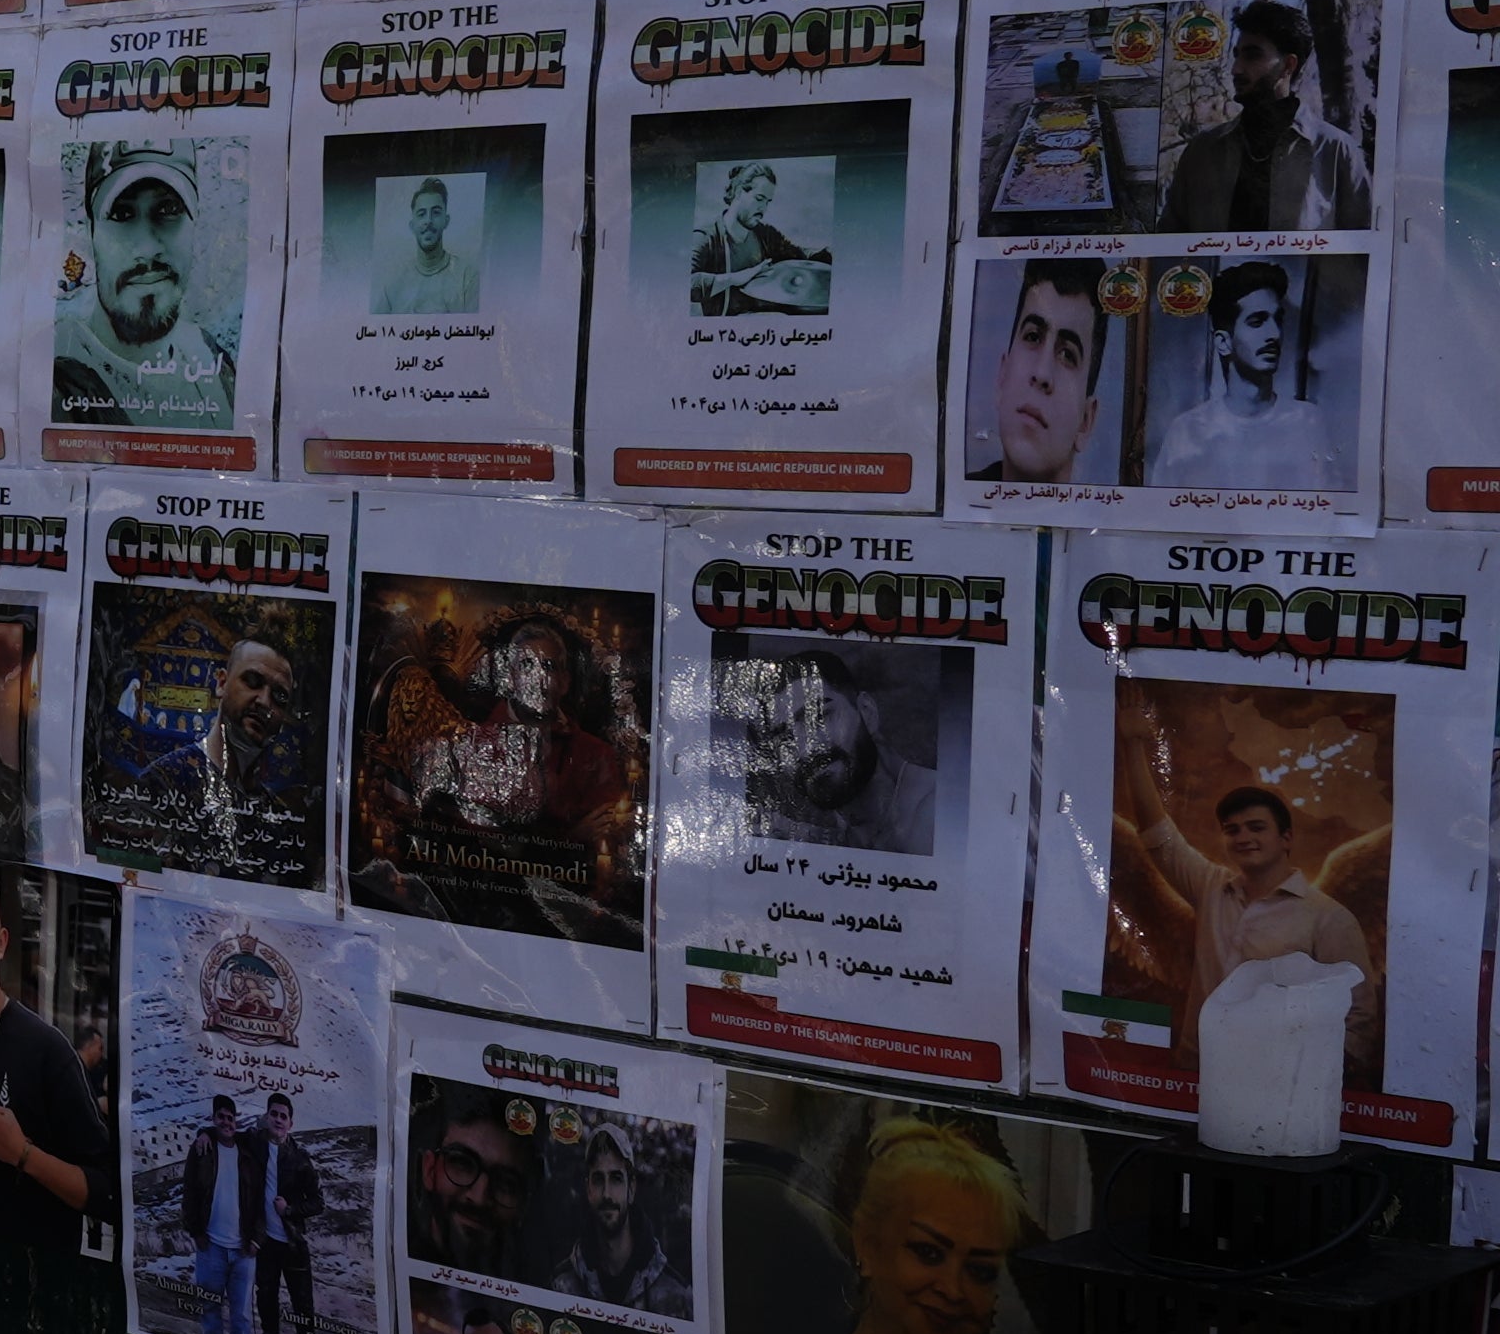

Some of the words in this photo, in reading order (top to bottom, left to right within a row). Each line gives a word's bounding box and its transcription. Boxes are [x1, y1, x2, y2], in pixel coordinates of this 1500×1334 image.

[631, 1, 925, 85] GENOCIDE
[1002, 239, 1039, 255] قاسمی
[1041, 238, 1072, 253] فرزام
[1074, 238, 1092, 251] نام
[1095, 239, 1125, 252] جاوید
[1187, 237, 1232, 253] رستمی
[1237, 235, 1261, 251] رضا
[1265, 234, 1286, 248] نام
[1299, 235, 1329, 249] جاوید
[1169, 492, 1221, 509] اجتهادی
[1228, 492, 1263, 508] ماهان
[1267, 495, 1287, 508] نام
[1292, 494, 1331, 511] جاوید
[1168, 545, 1263, 572] STOP
[1276, 550, 1357, 577] THE
[1077, 572, 1467, 669] GENOCIDE
[406, 834, 438, 863] Ali
[444, 844, 589, 885] Mohammadi
[744, 854, 778, 875] سال
[785, 858, 810, 876] ۲۴
[877, 874, 938, 892] محمود
[768, 901, 824, 923] سمنان
[220, 1015, 280, 1033] MIGA.RALLY
[197, 1043, 213, 1059] بود
[217, 1047, 237, 1064] زدن
[239, 1052, 261, 1068] بوق
[264, 1056, 287, 1069] فقط
[290, 1063, 340, 1083] جرمشون
[258, 1077, 289, 1091] تاریخ
[291, 1084, 303, 1095] در
[156, 1275, 194, 1296] Ahmad
[196, 1287, 222, 1304] Reza
[177, 1297, 204, 1315] Feyzi
[281, 1310, 312, 1327] Amir
